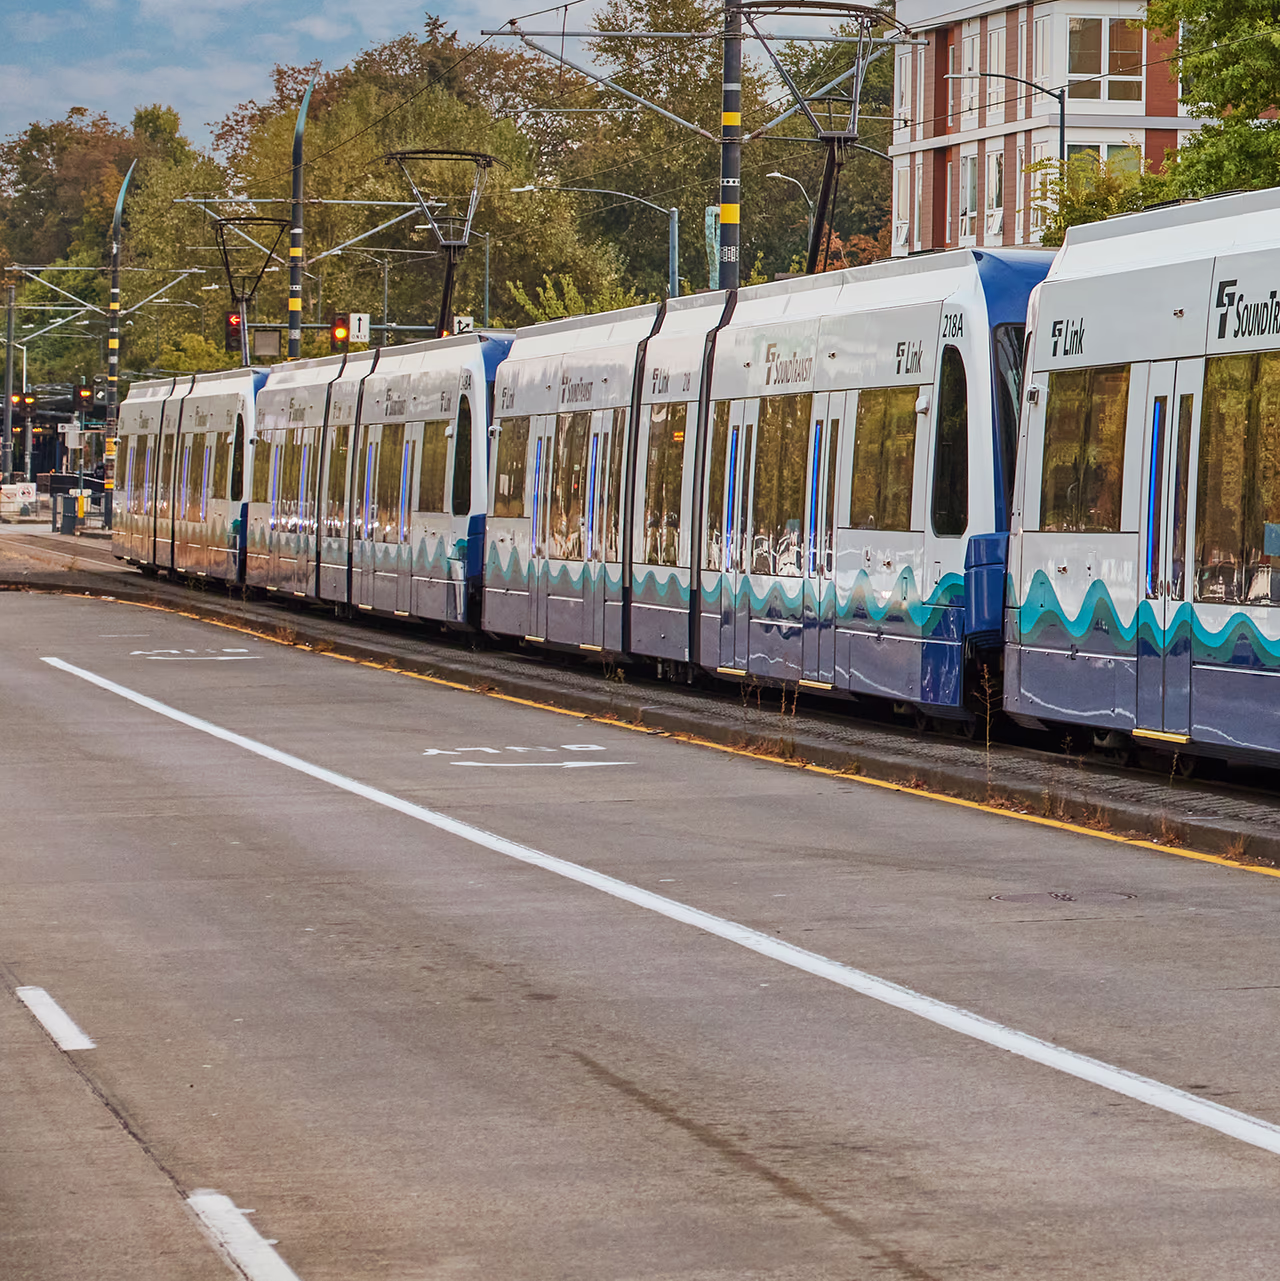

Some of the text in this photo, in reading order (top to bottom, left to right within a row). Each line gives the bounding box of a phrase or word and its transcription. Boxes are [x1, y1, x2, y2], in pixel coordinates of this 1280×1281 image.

[942, 312, 964, 338] 218A
[1063, 317, 1085, 356] Link
[905, 340, 923, 375] Link
